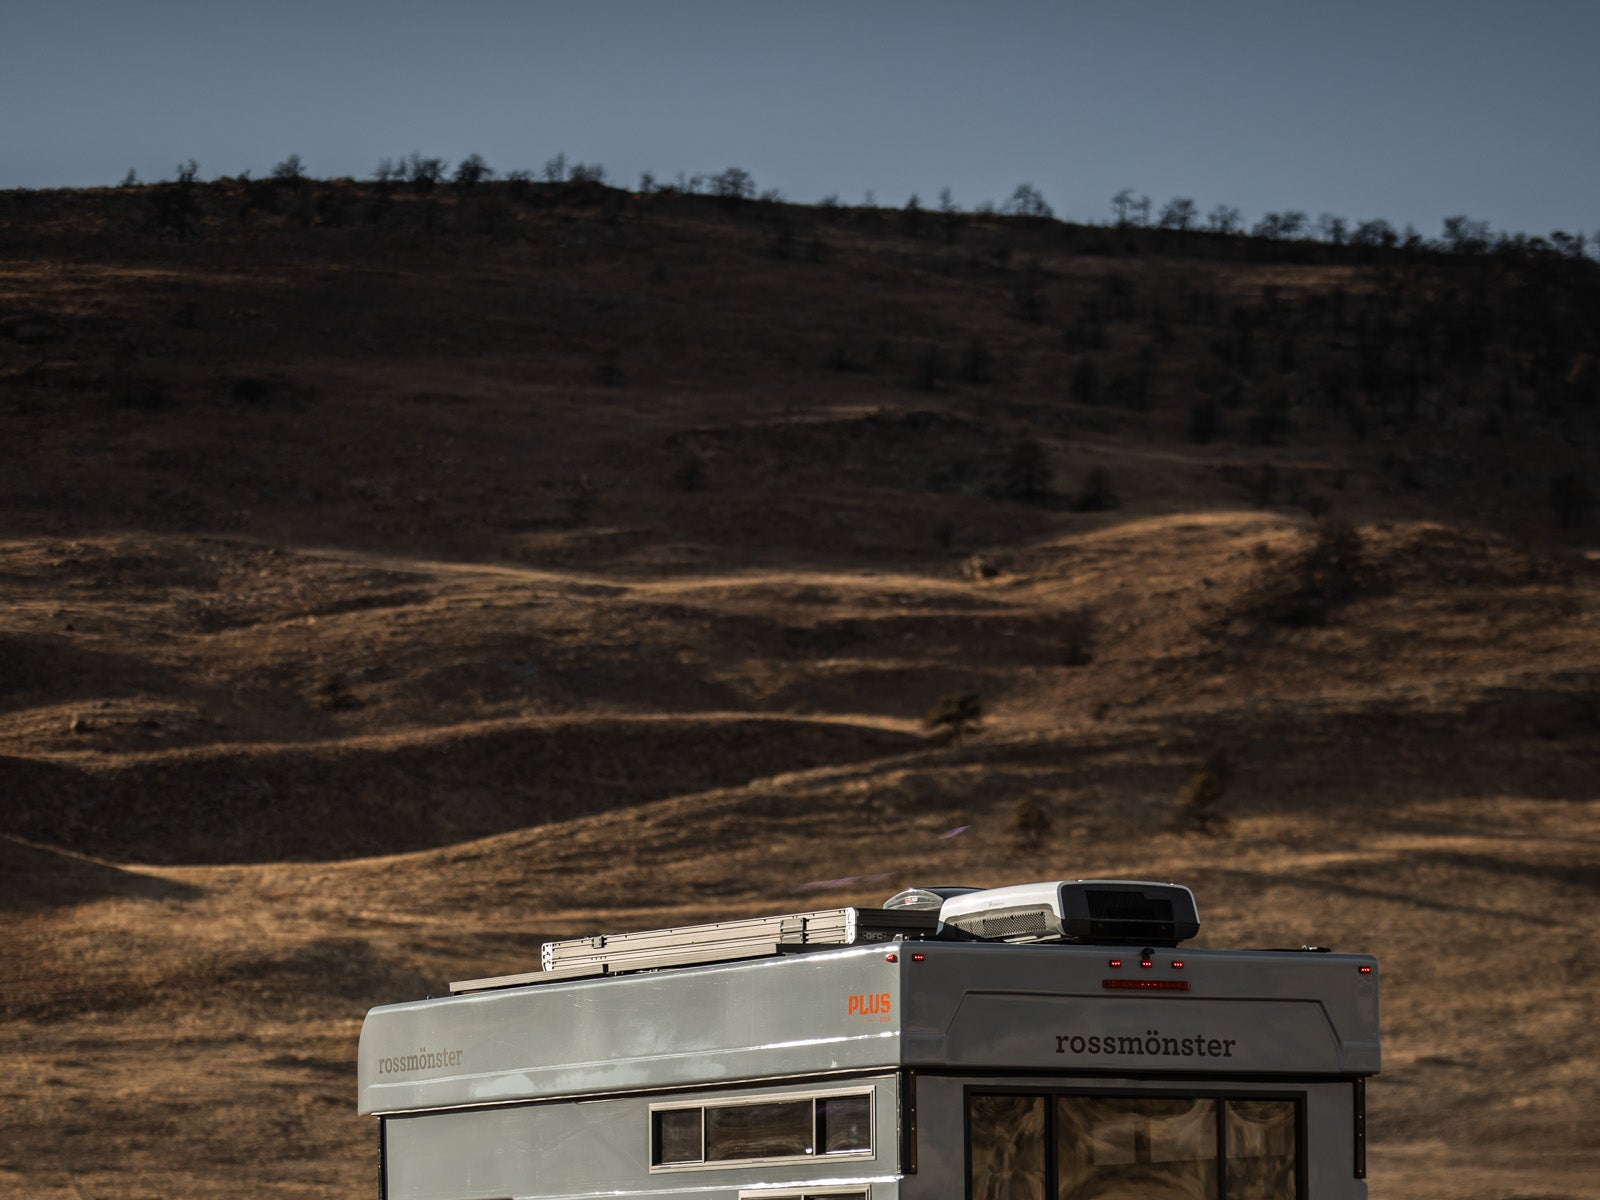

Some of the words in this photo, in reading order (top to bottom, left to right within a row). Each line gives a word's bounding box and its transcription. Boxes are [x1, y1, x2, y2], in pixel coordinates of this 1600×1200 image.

[847, 992, 891, 1016] PLUS
[1055, 1029, 1236, 1057] rossmönster
[378, 1047, 463, 1074] rossmönster
